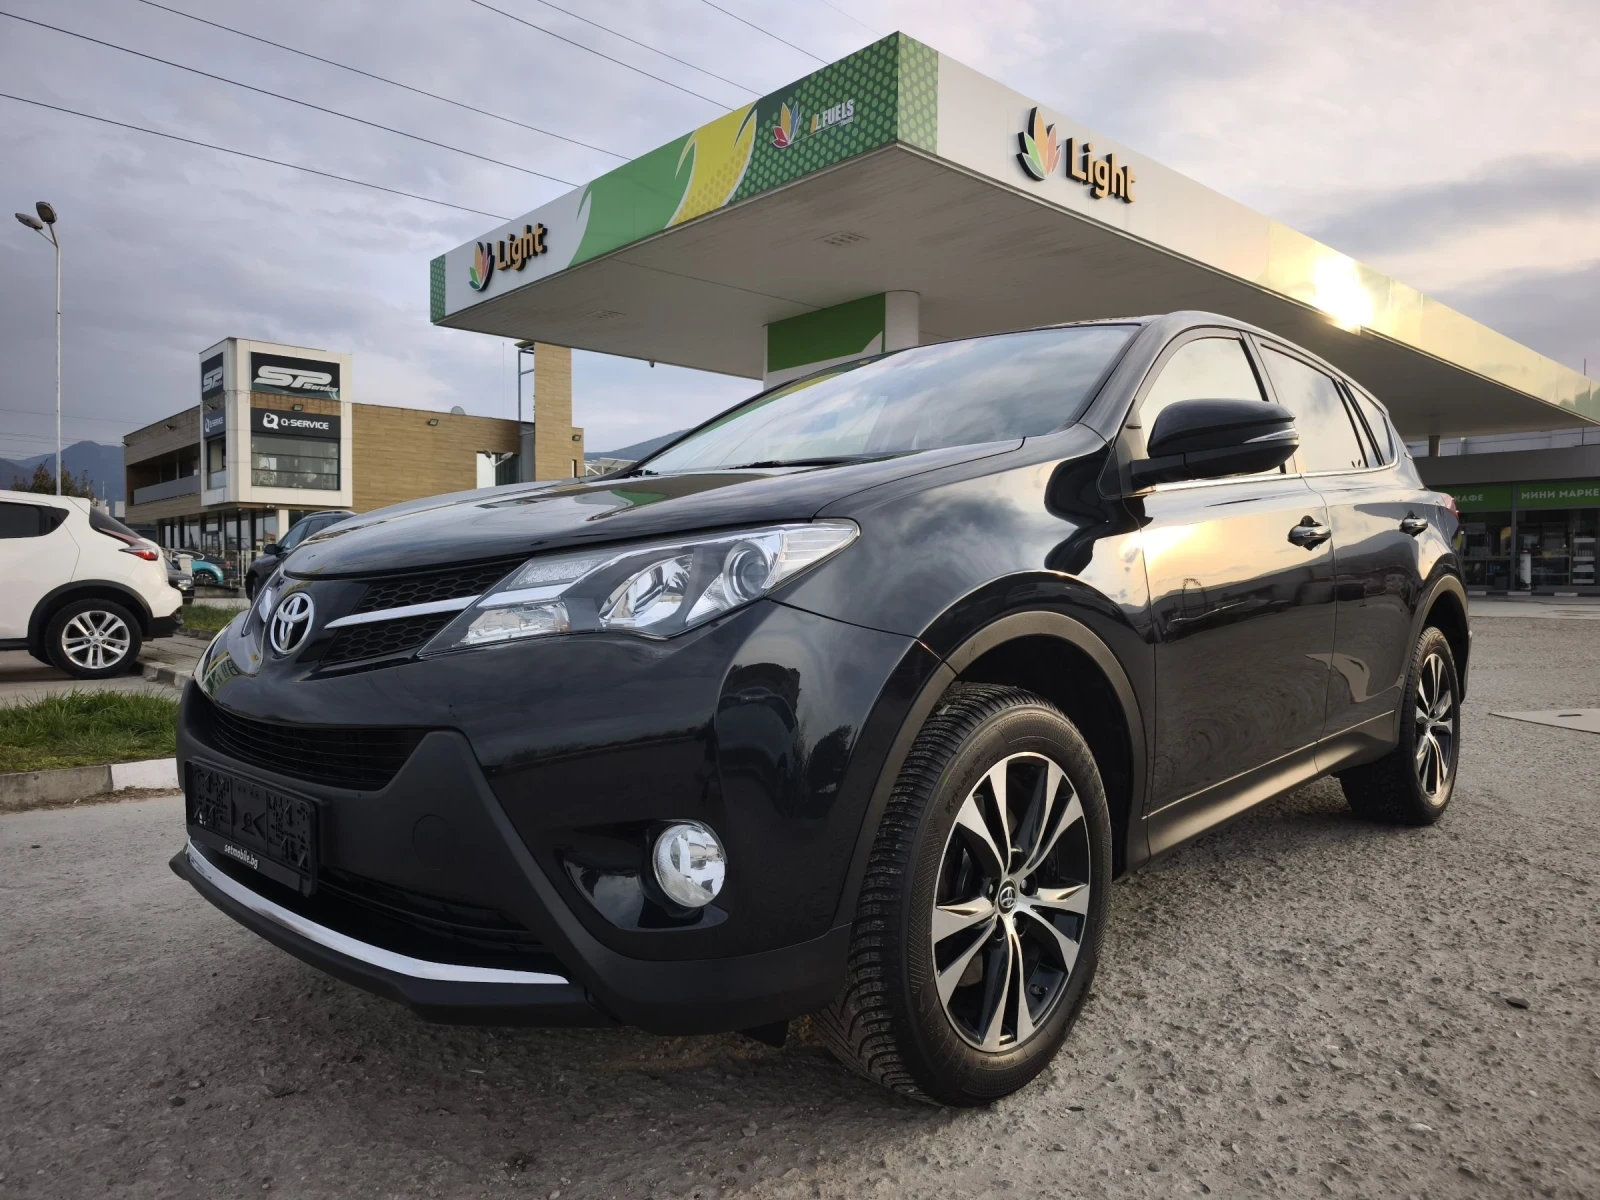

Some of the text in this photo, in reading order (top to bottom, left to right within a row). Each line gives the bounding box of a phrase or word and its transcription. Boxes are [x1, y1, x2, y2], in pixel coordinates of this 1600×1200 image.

[1066, 137, 1137, 203] Light
[496, 223, 548, 271] Light
[202, 366, 223, 392] SP
[253, 365, 332, 389] SP
[280, 419, 330, 430] Q-SERVICE
[1521, 490, 1556, 500] МИНИ
[224, 844, 259, 869] setmobile.bg
